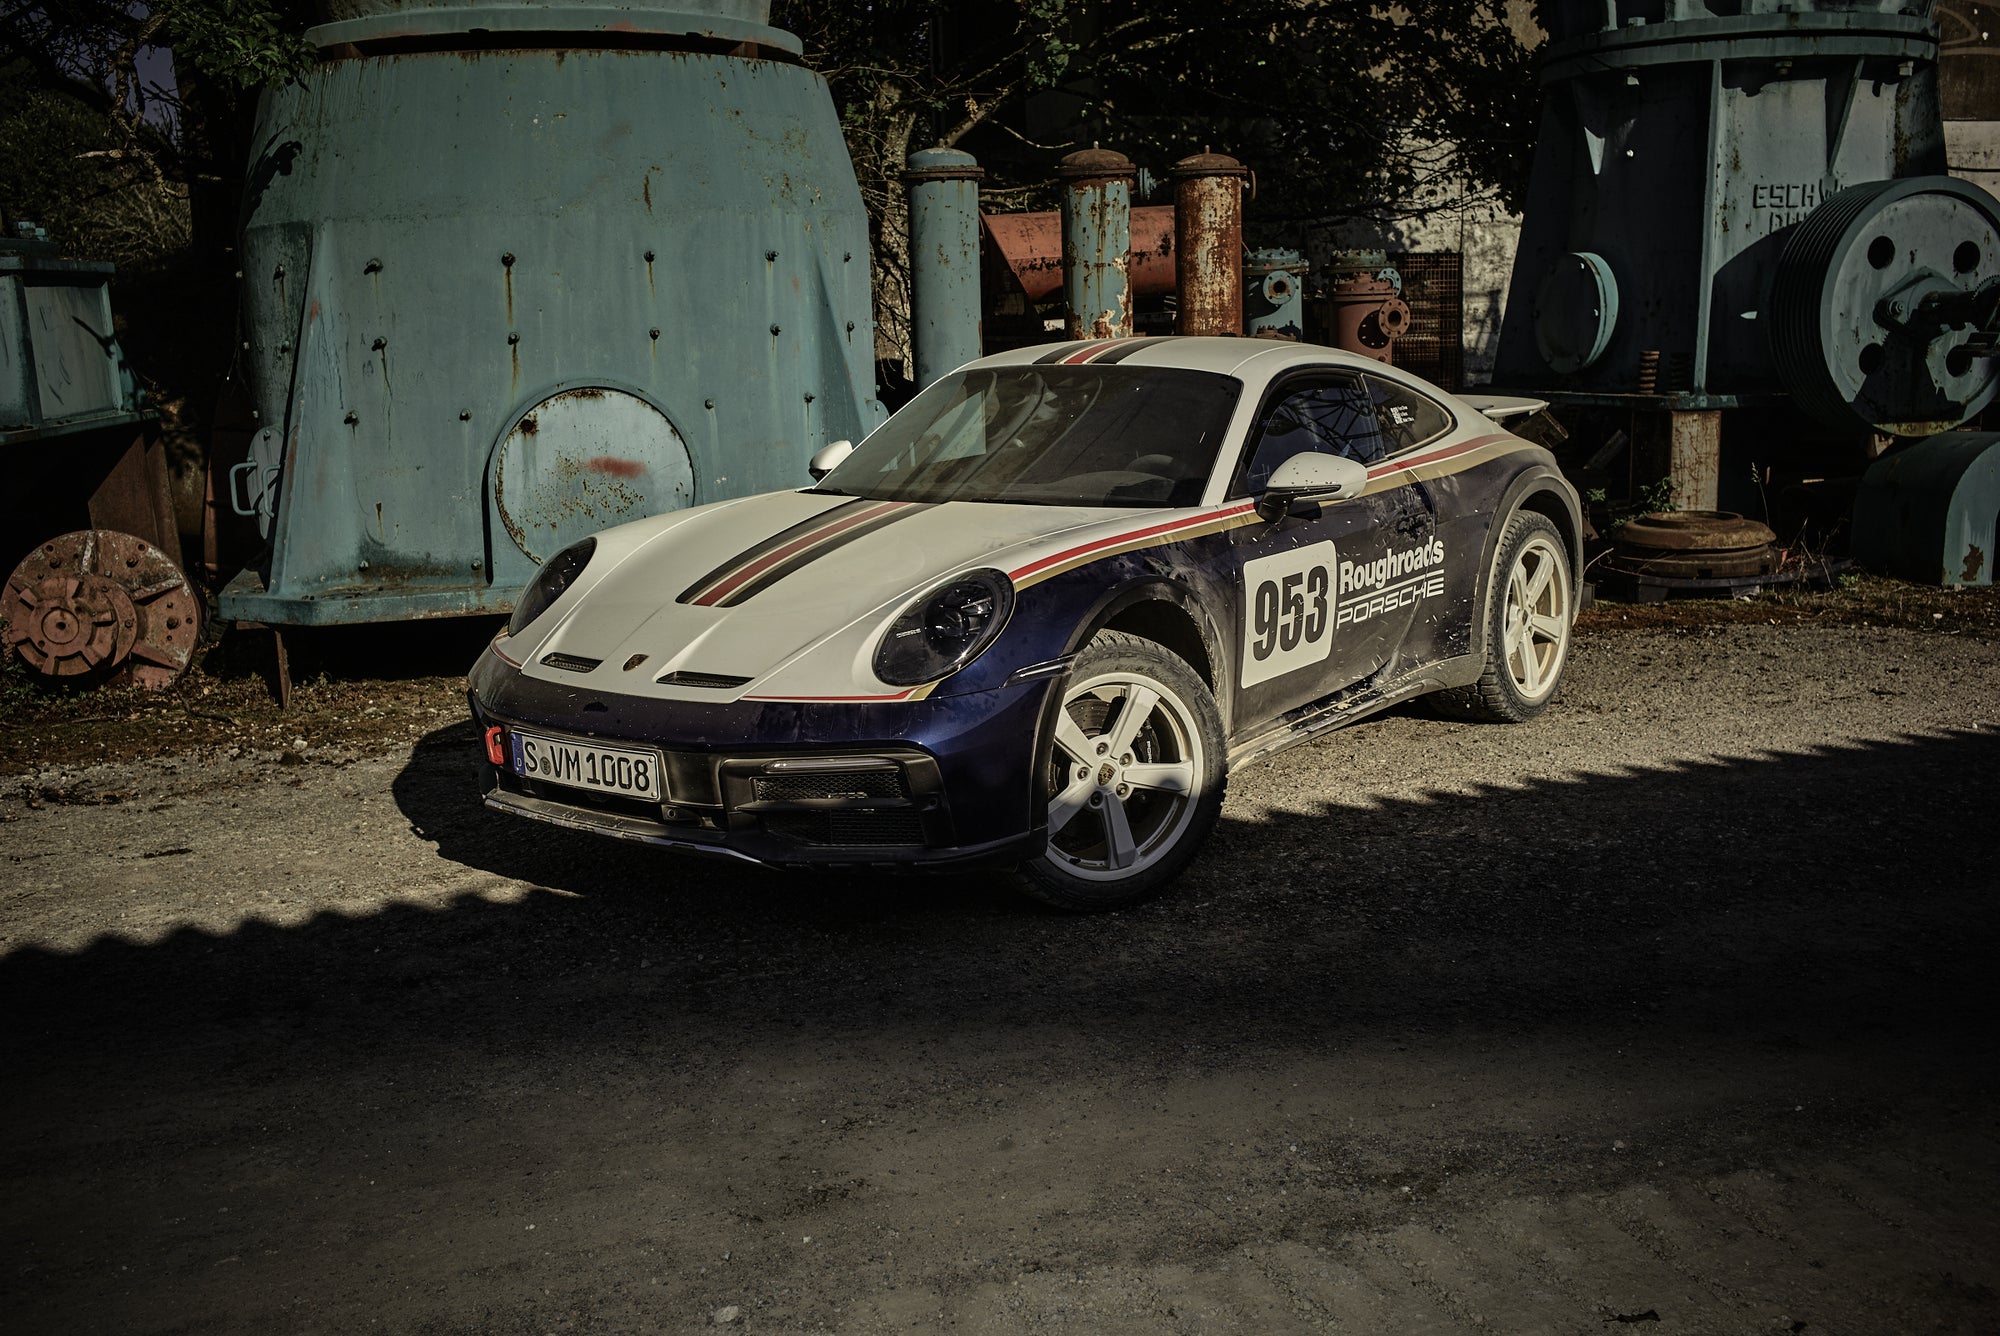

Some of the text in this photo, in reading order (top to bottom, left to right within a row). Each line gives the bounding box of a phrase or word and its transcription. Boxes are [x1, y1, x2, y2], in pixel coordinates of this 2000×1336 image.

[1339, 536, 1444, 595] Roughroads
[1253, 566, 1328, 661] 953
[1336, 577, 1444, 630] PORSCHE
